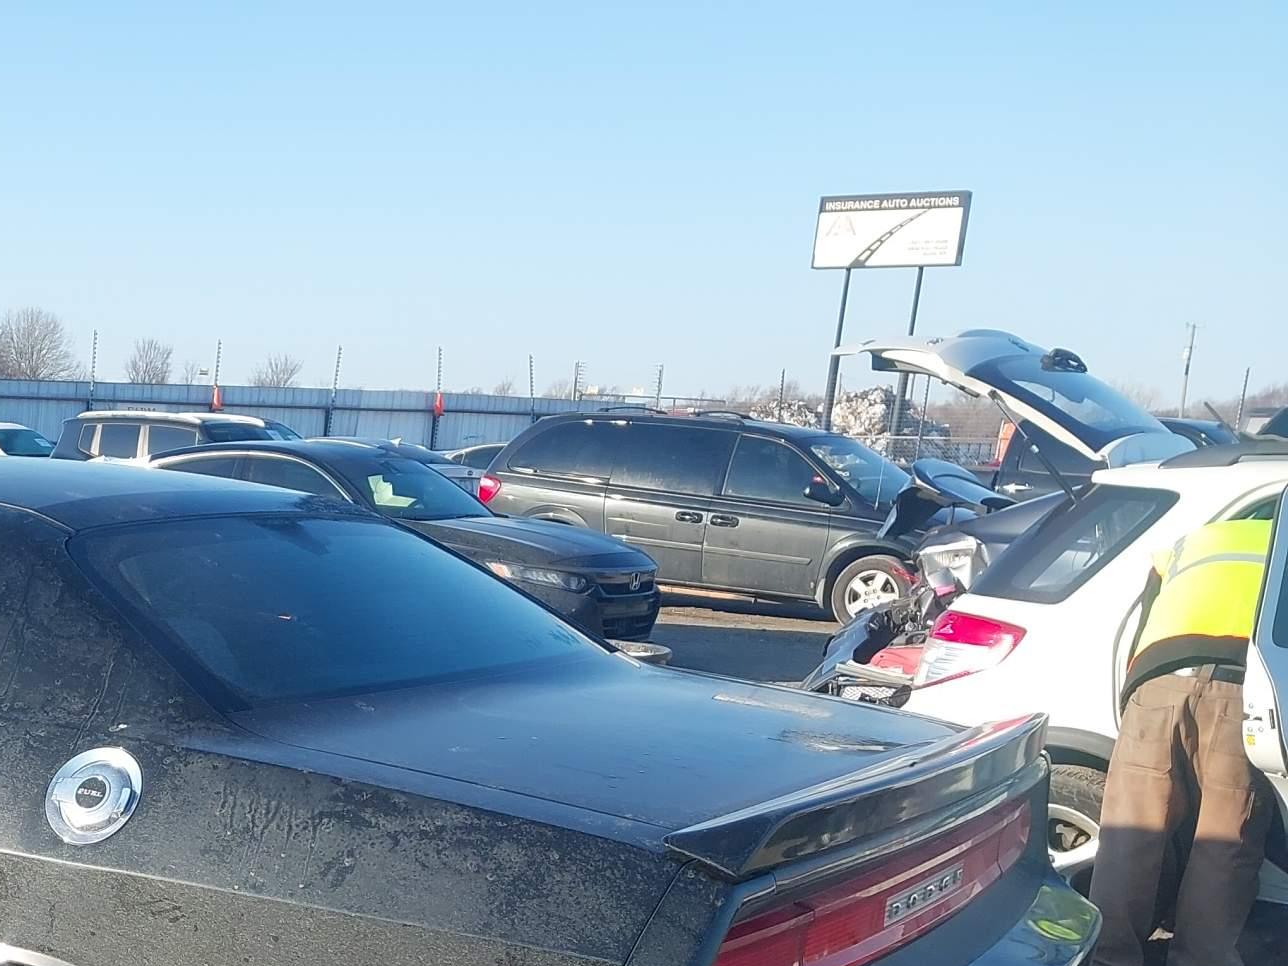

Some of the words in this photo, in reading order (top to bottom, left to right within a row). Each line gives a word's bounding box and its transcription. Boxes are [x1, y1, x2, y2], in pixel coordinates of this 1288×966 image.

[825, 200, 880, 211] INSURANCE
[881, 198, 908, 210] AUTO
[909, 196, 960, 208] AUCTIONS
